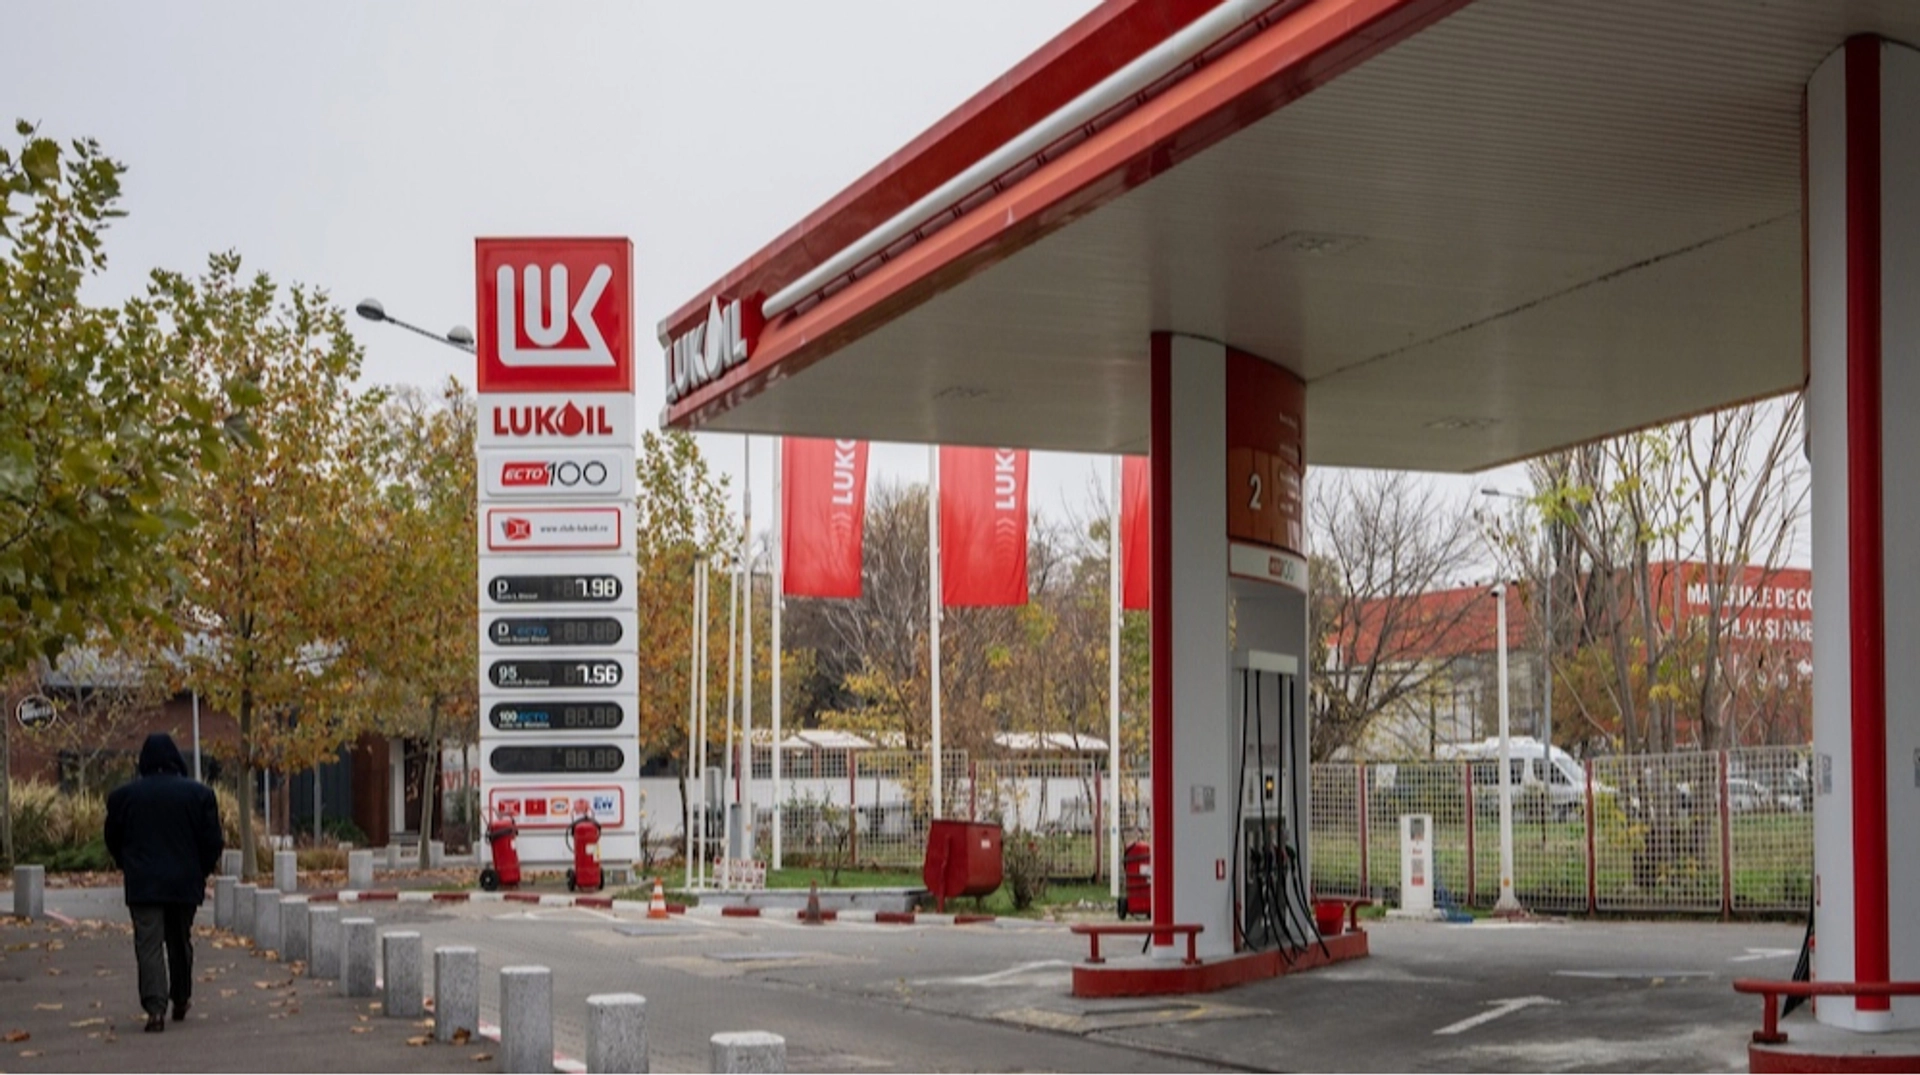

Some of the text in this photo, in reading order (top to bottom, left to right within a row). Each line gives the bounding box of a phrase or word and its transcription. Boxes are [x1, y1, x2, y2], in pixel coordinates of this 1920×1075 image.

[496, 263, 617, 367] LUK
[493, 401, 613, 437] LUKOIL
[547, 461, 608, 487] 100
[995, 448, 1016, 510] LUK
[1249, 472, 1262, 510] 2
[496, 578, 617, 597] D 7.98
[498, 623, 509, 636] D
[576, 664, 618, 684] 7.56
